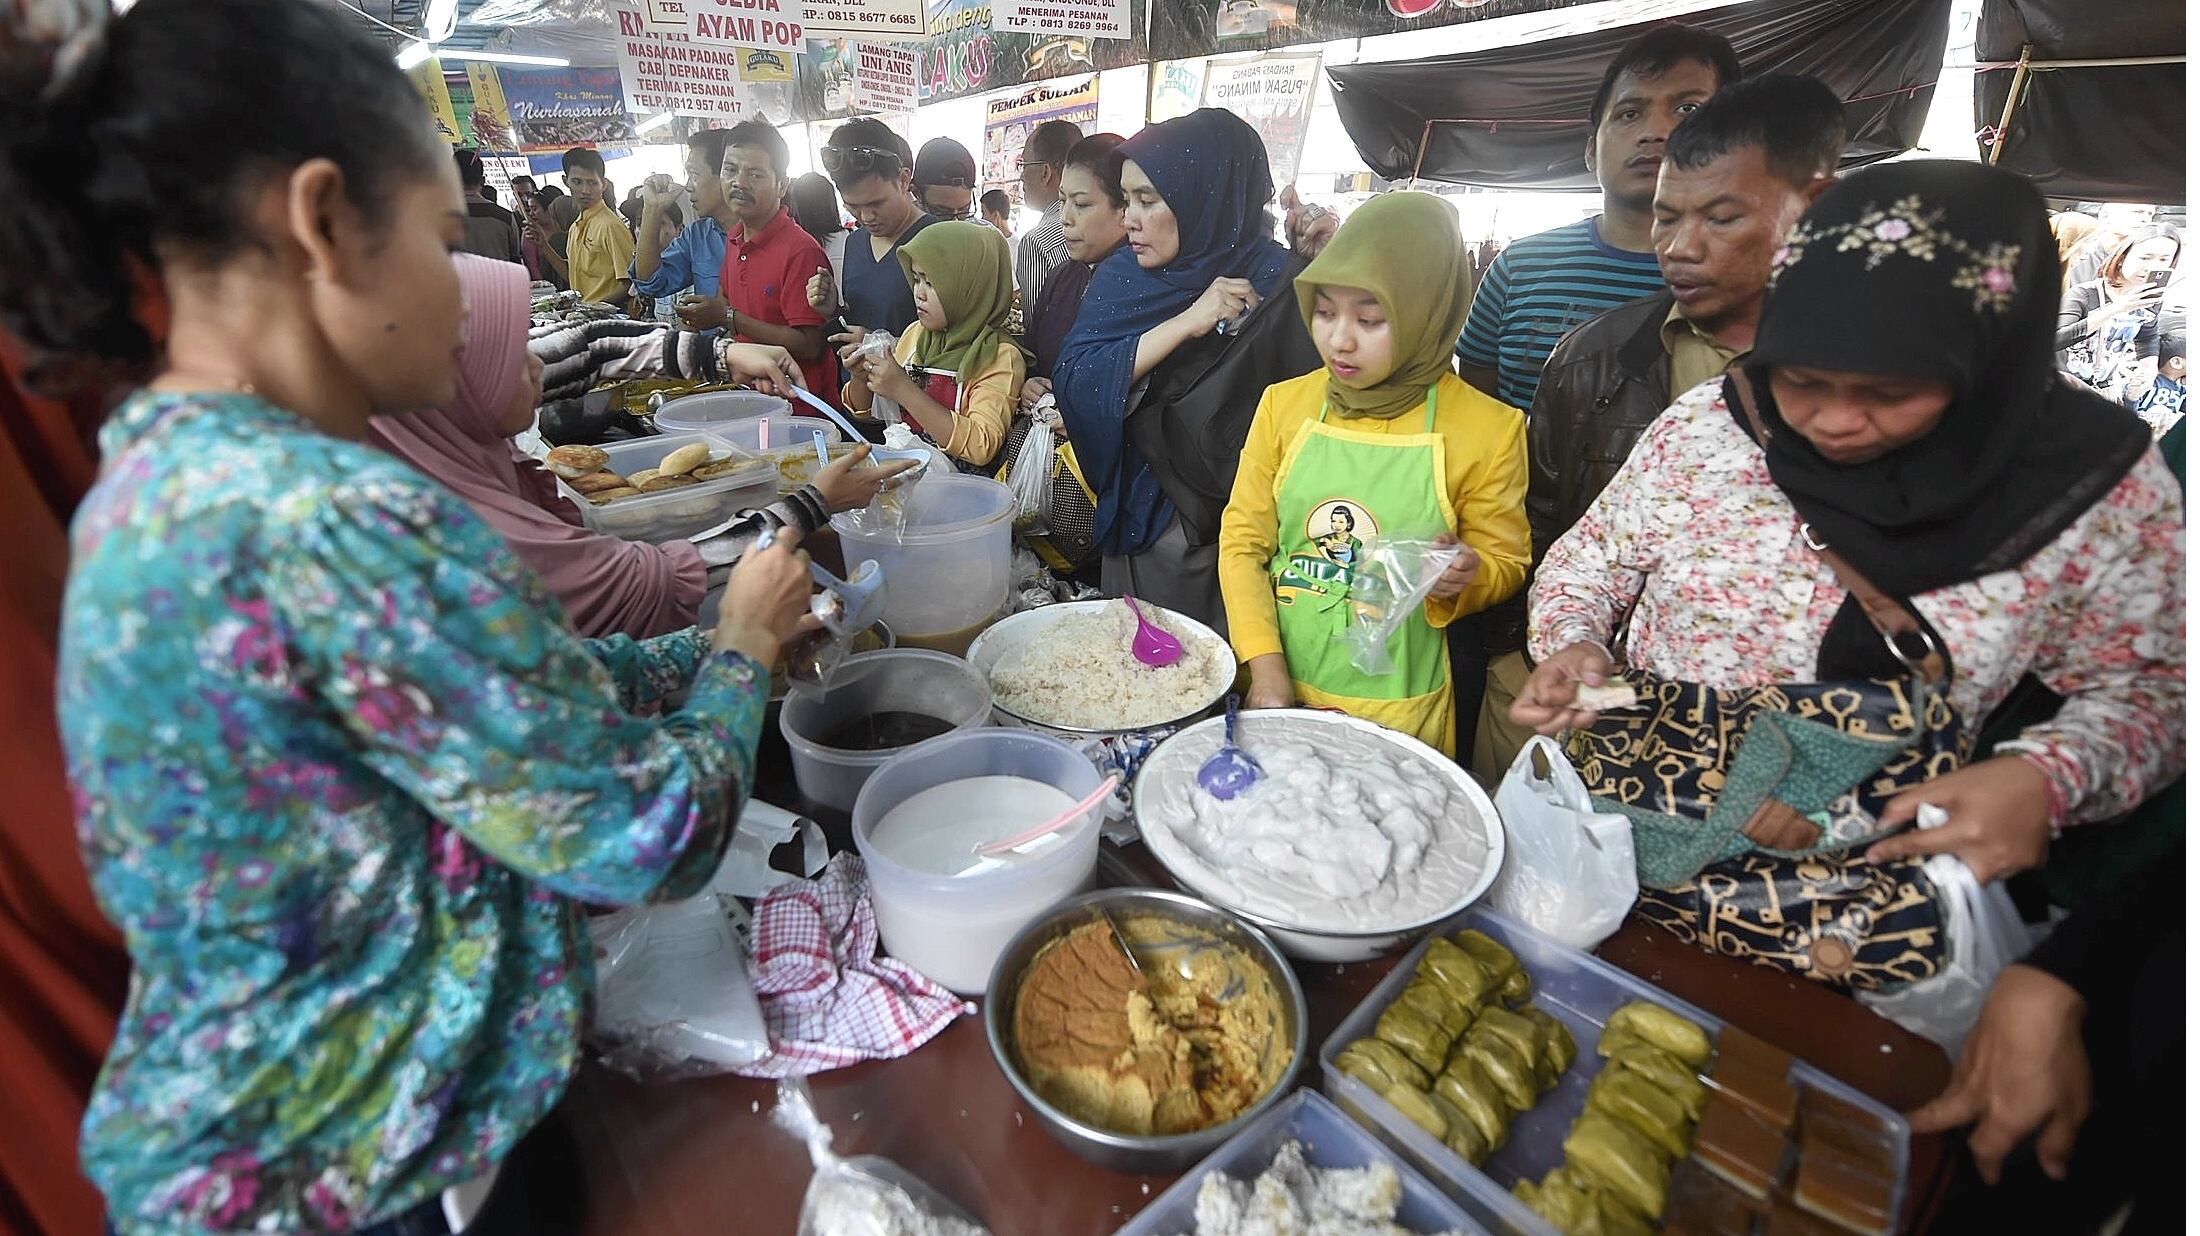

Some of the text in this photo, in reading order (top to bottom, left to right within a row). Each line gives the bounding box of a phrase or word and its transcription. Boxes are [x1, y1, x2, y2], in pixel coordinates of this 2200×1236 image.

[827, 10, 856, 21] 0815
[859, 12, 886, 23] 8677
[889, 14, 916, 25] 6685
[1018, 6, 1108, 20] MENERIMA PESANAN
[696, 13, 802, 46] AYAM POP
[1007, 16, 1028, 26] TLP
[1040, 18, 1063, 28] 0813
[1067, 20, 1091, 30] 8269
[1095, 21, 1119, 31] 9964
[627, 42, 735, 66] MASAKAN PADANG
[857, 43, 915, 62] LAMANG TAPAI
[669, 63, 730, 81] DEPNAKER
[861, 54, 912, 76] UNI ANIS
[637, 78, 735, 97] TERIMA PESANAN
[514, 100, 624, 120] Nurhasanah
[666, 96, 693, 110] 0812
[695, 99, 714, 111] 957
[717, 101, 742, 113] 4017
[990, 92, 1036, 114] PEMPEK
